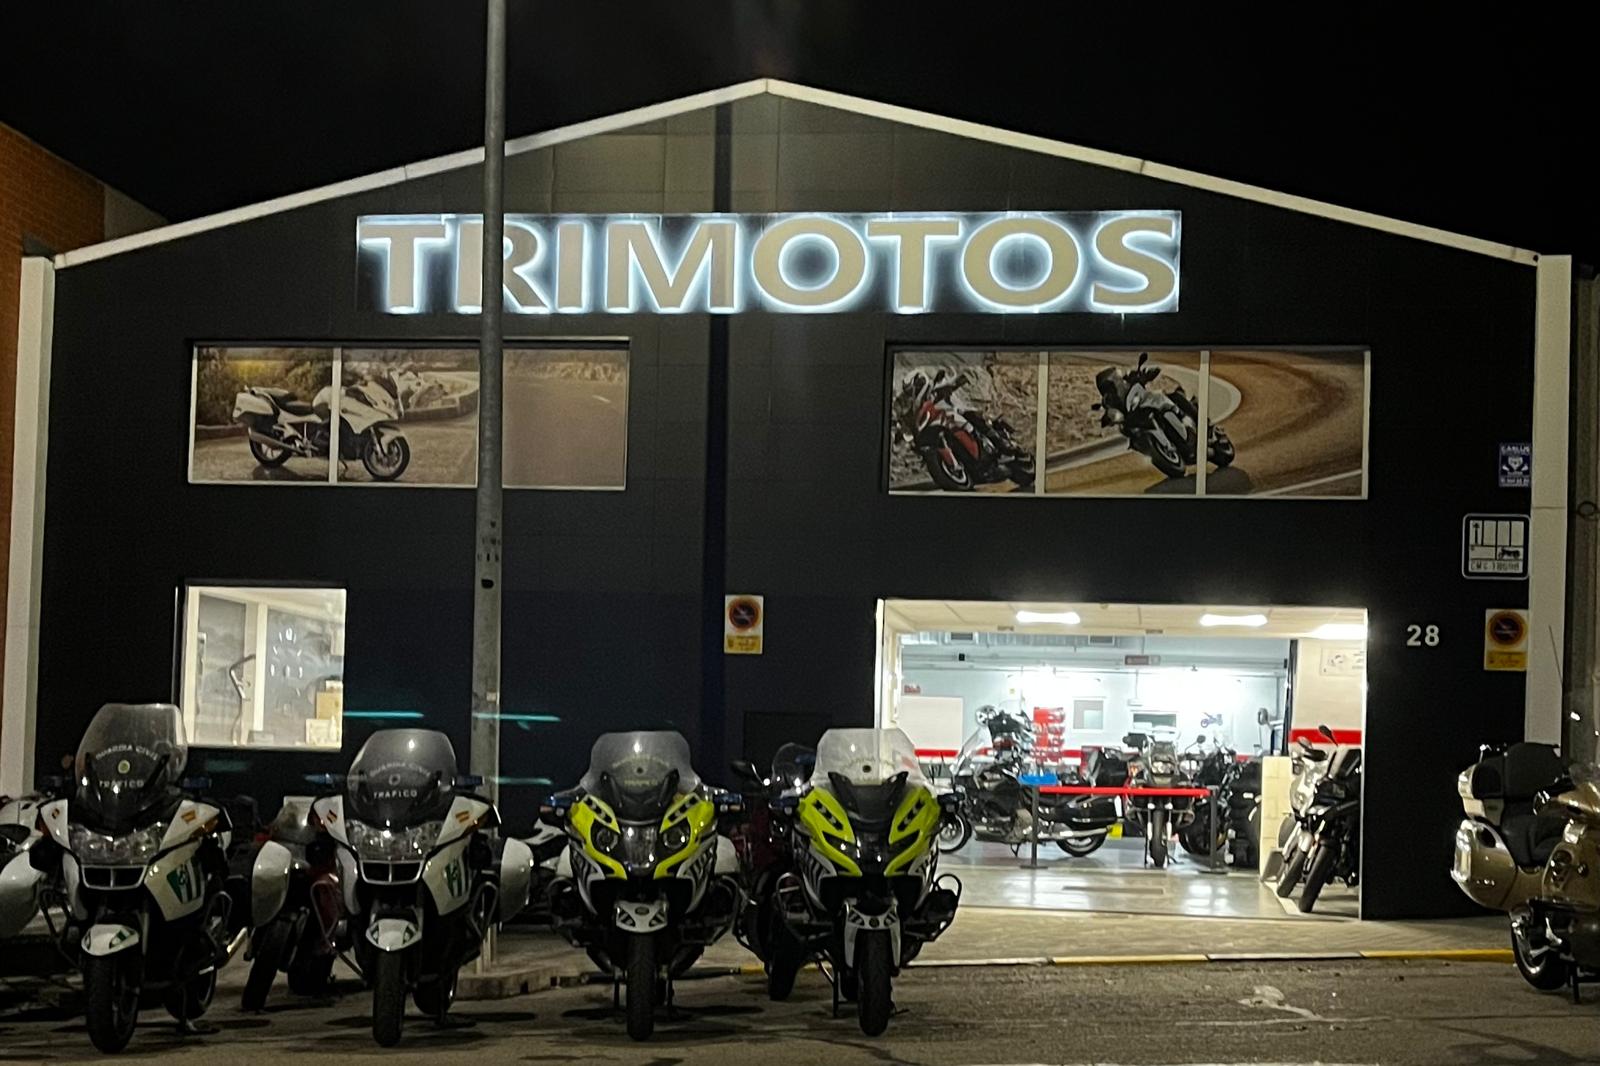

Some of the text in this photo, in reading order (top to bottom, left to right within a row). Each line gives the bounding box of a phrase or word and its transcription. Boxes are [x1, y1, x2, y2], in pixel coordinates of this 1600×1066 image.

[359, 214, 1178, 310] TRIMOTOS
[1407, 624, 1440, 647] 28
[374, 789, 418, 799] TRAFICO
